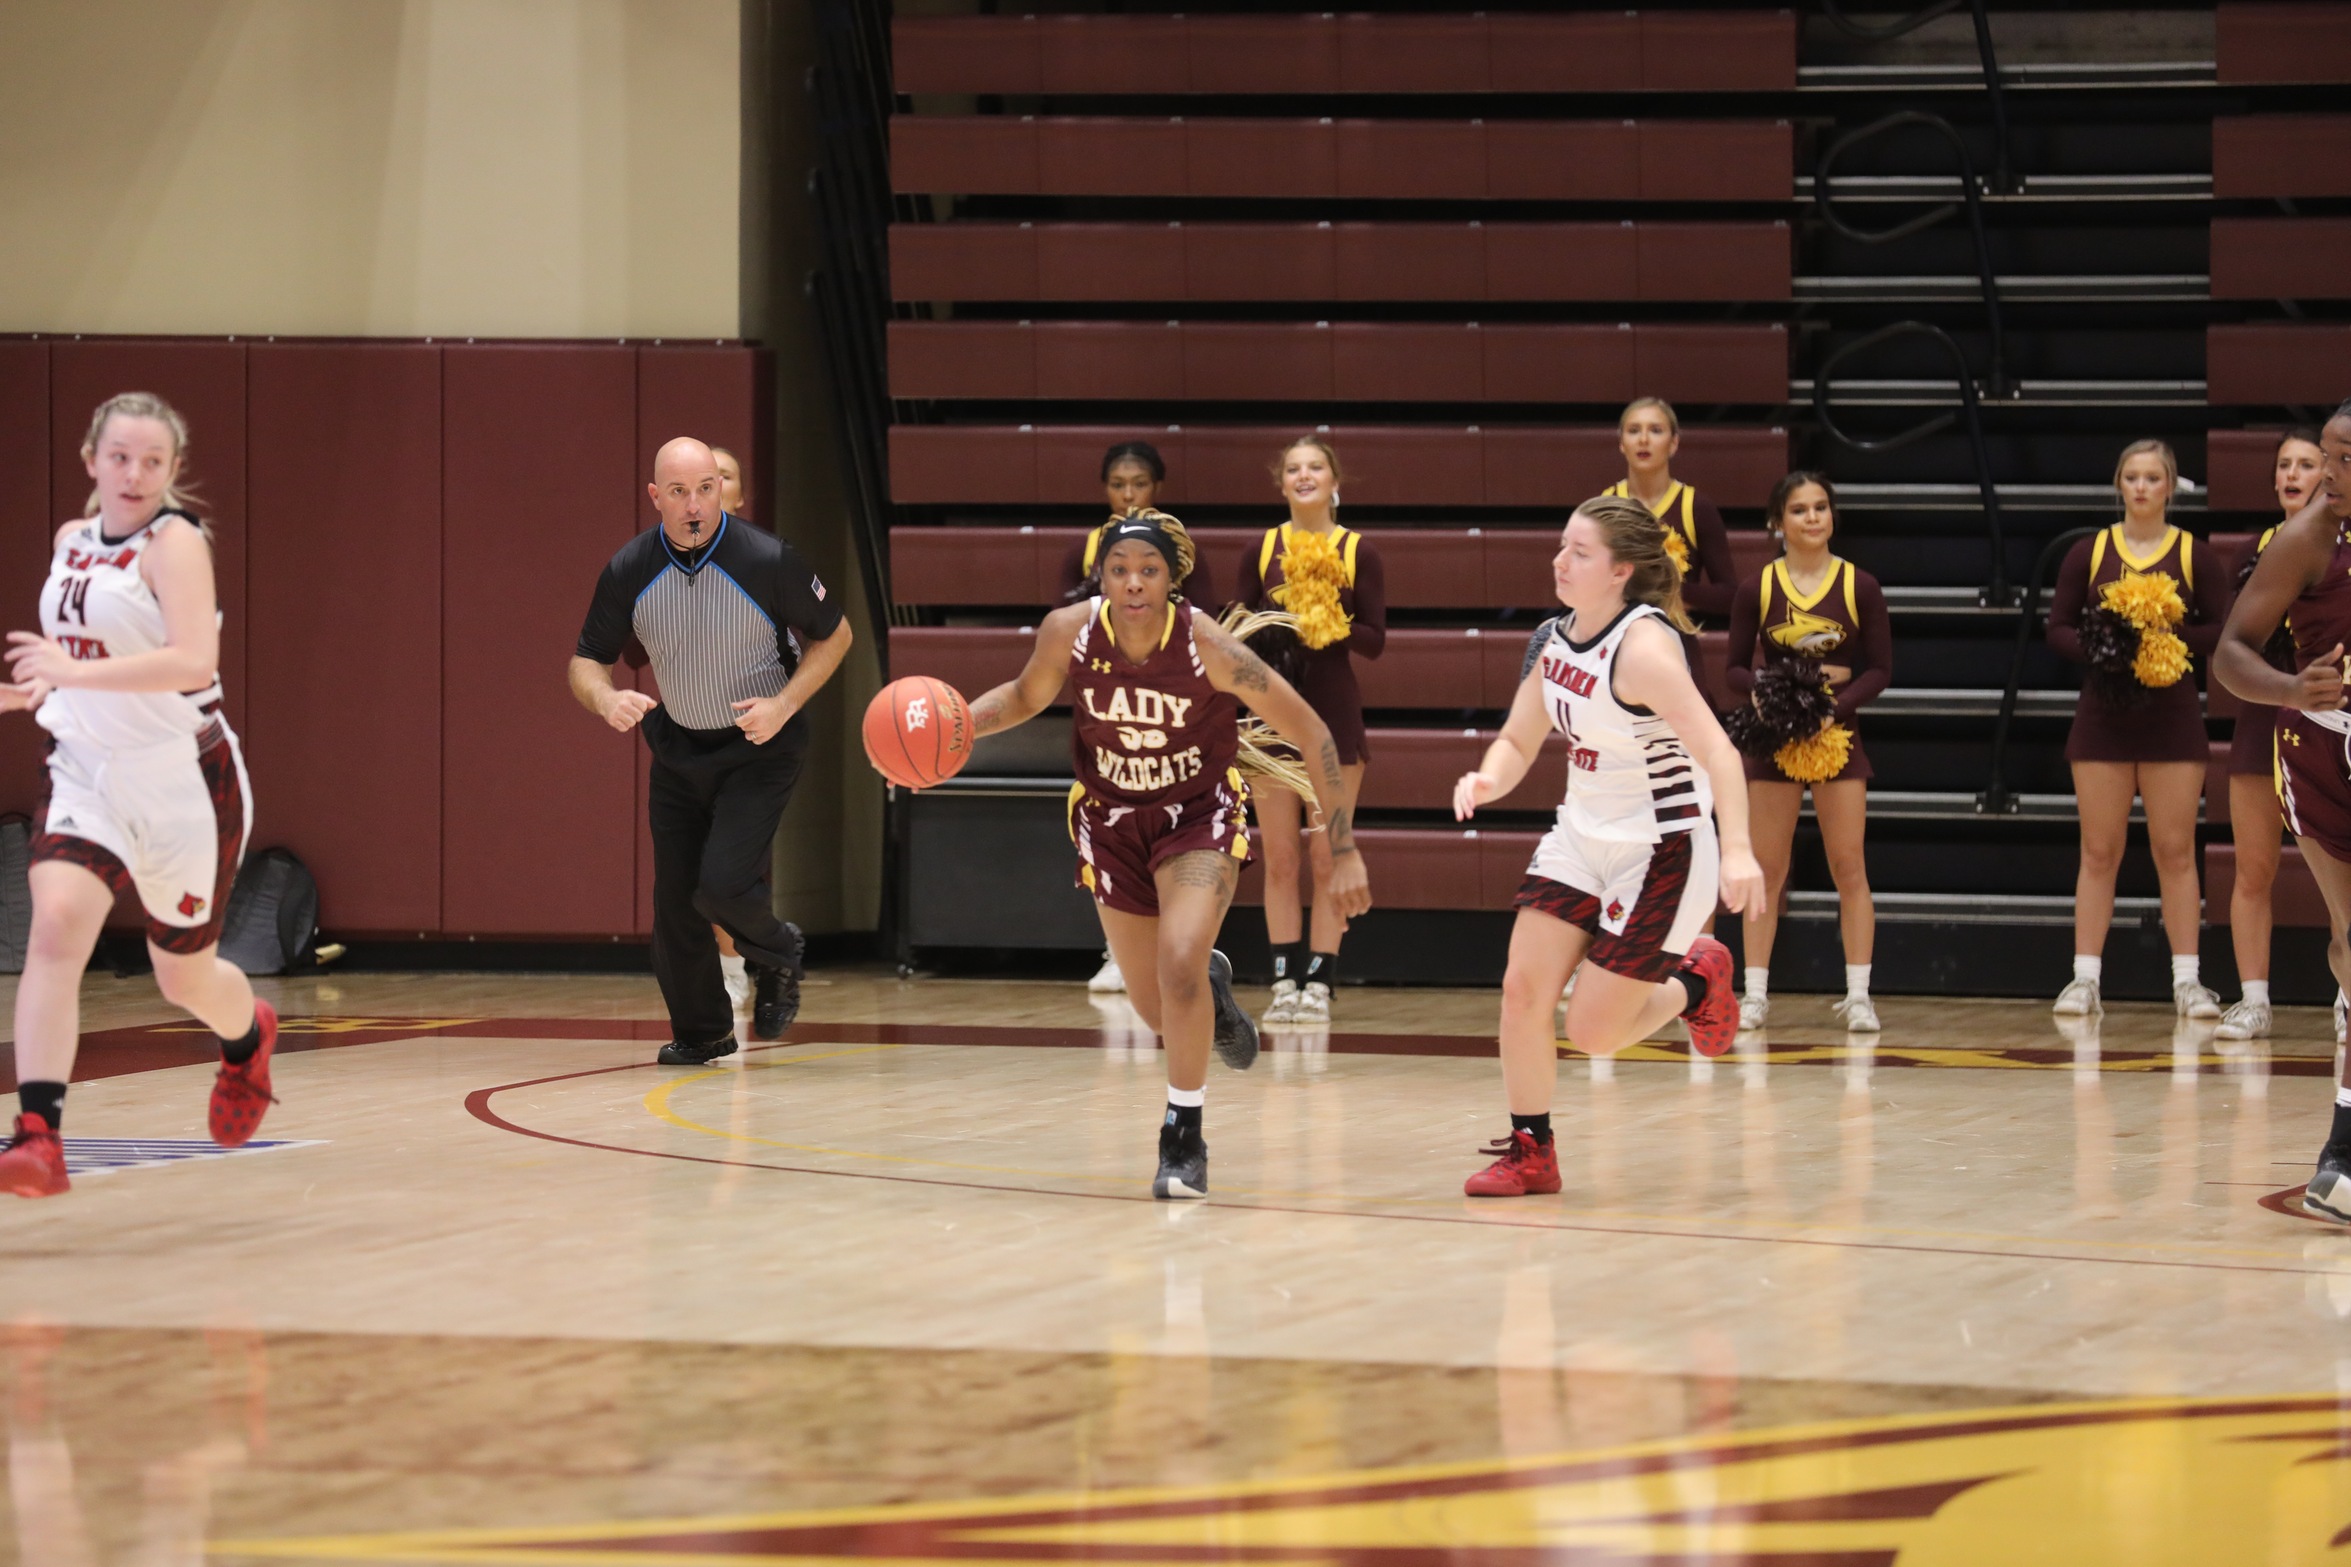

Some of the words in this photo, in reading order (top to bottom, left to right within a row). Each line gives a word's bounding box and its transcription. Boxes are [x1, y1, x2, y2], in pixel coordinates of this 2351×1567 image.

[57, 577, 91, 627] 24
[1083, 687, 1192, 728] LADY
[1096, 745, 1202, 791] WILDCATS
